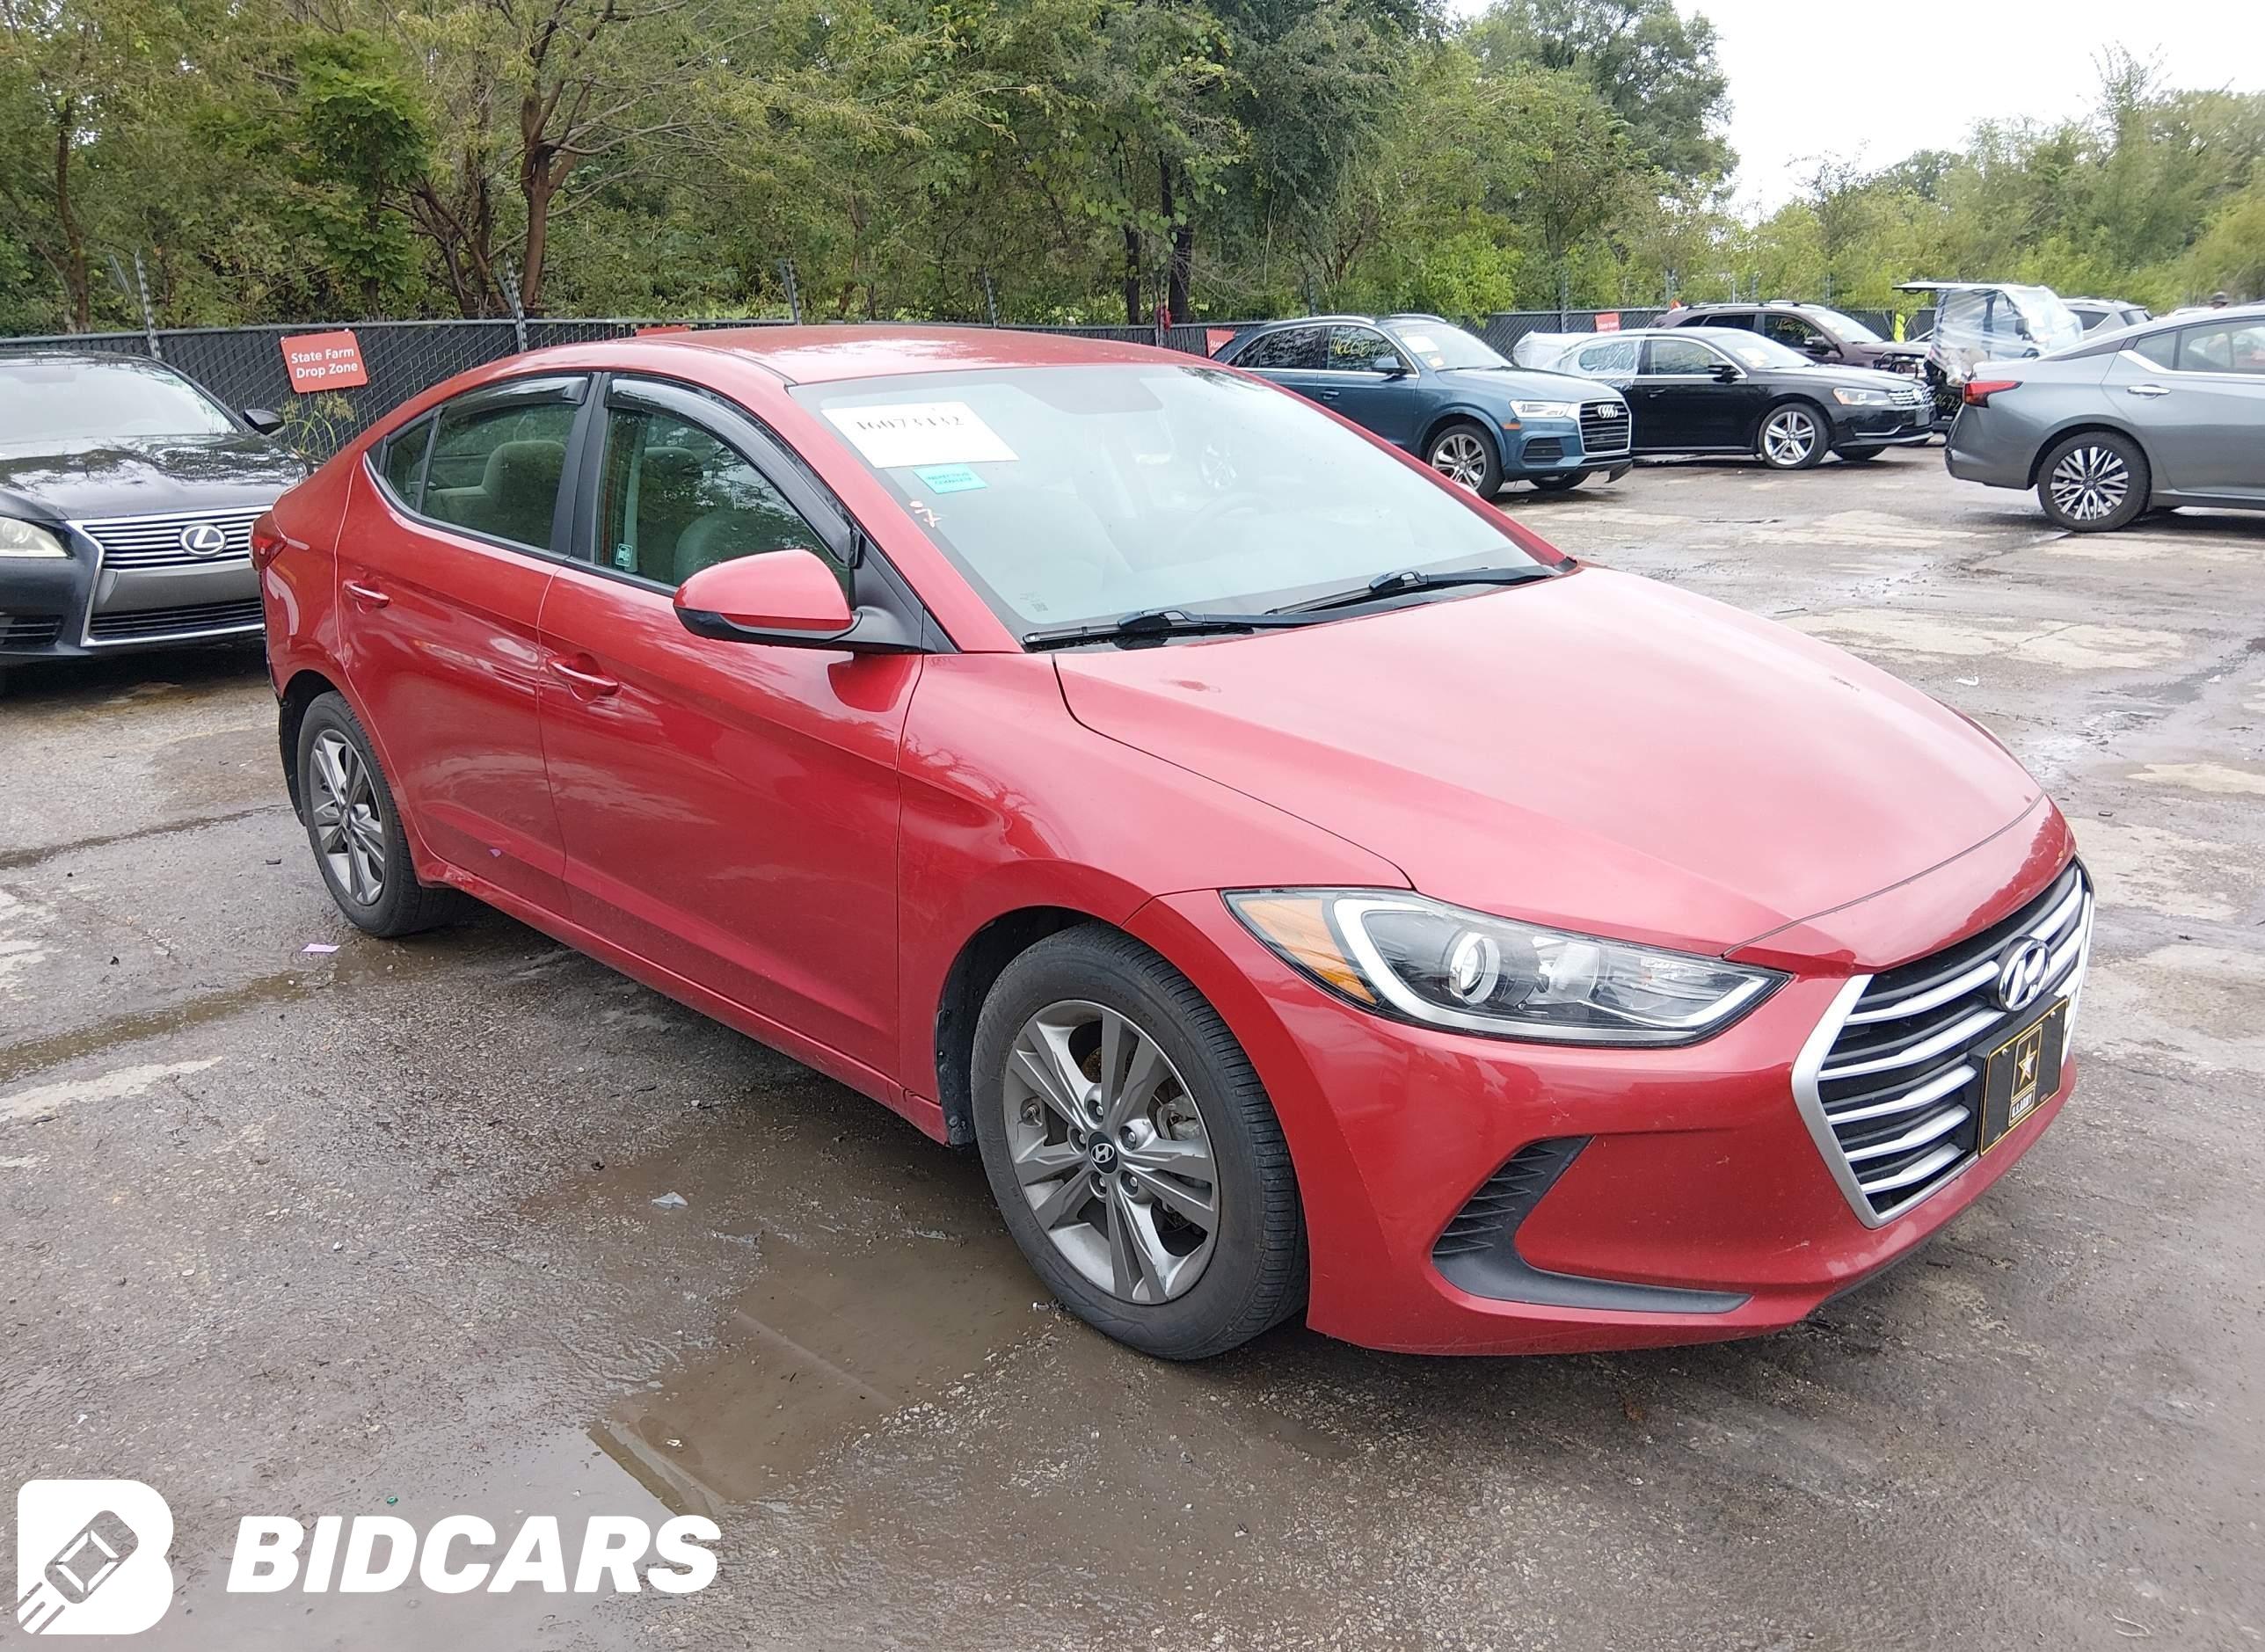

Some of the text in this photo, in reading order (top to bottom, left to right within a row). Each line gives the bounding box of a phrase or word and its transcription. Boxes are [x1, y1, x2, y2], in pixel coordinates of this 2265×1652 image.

[291, 348, 354, 364] State Farm
[296, 362, 358, 379] Drop Zone
